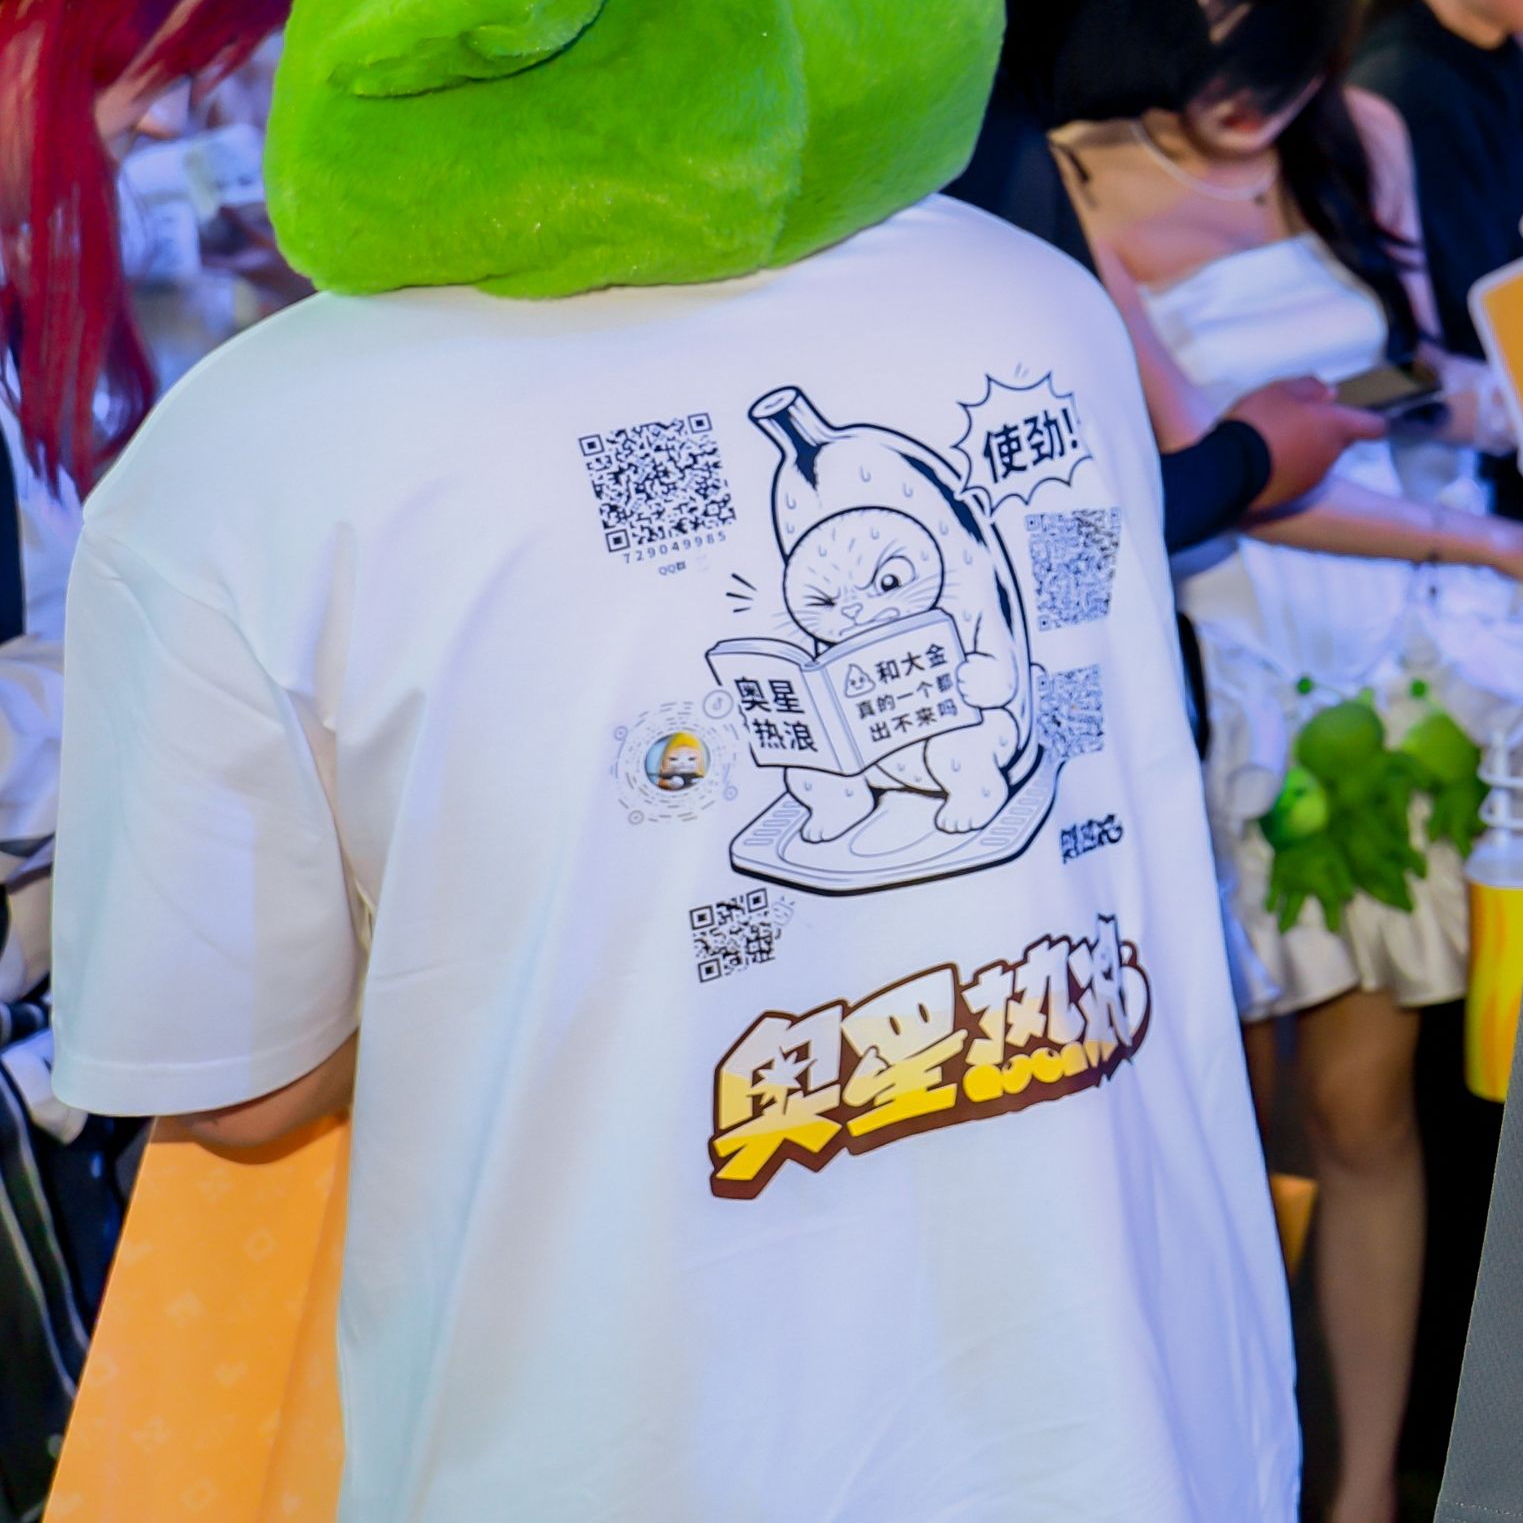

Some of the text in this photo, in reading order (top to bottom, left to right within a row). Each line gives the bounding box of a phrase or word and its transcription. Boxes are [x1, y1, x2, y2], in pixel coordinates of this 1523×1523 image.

[623, 530, 727, 564] 729049985
[875, 643, 947, 684] 和大金
[734, 676, 805, 714] 奥星
[752, 718, 818, 752] 热浪
[869, 698, 958, 742] 出不来吗
